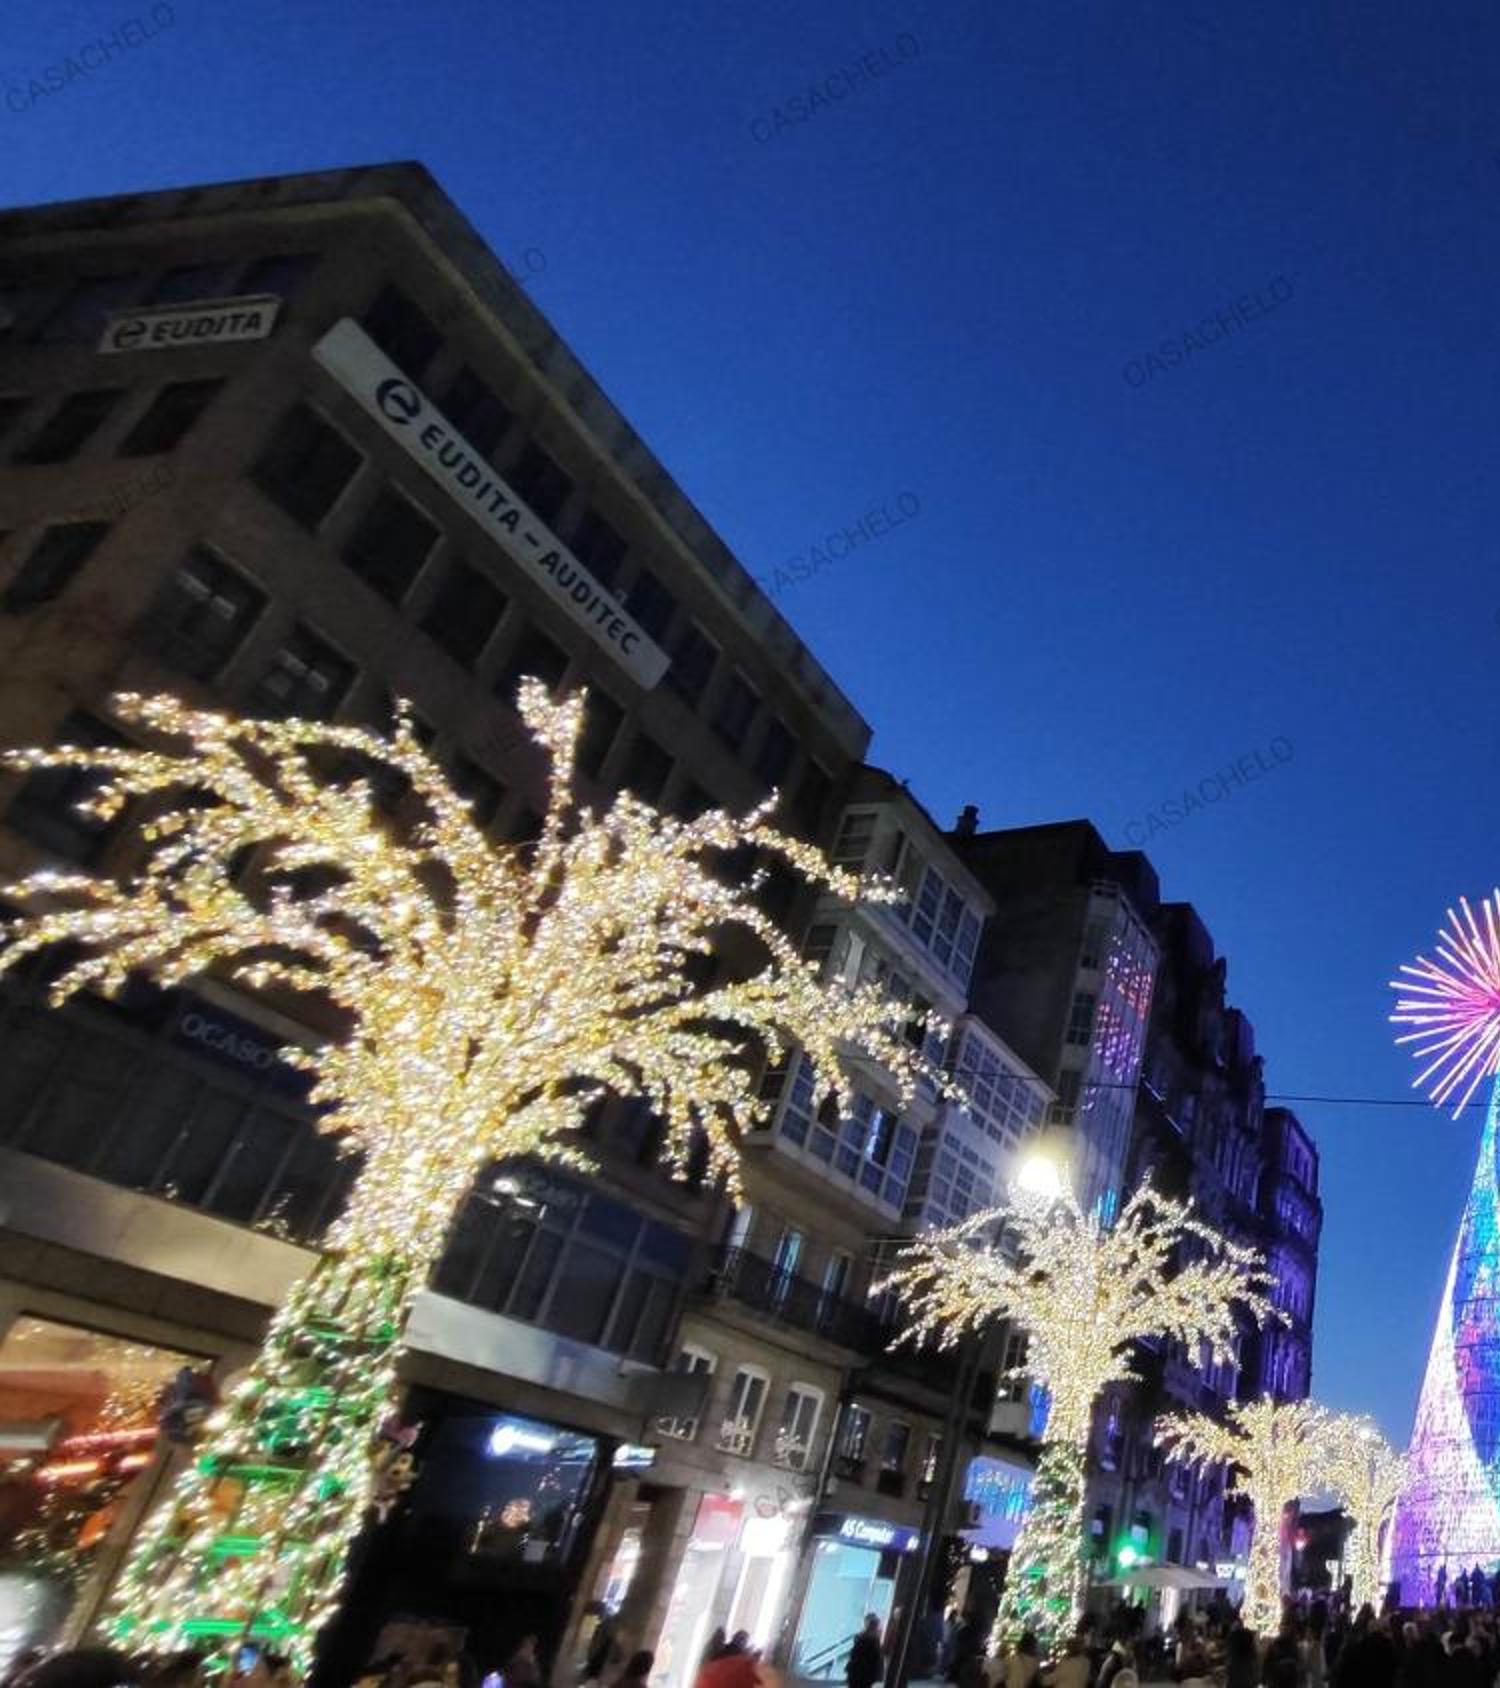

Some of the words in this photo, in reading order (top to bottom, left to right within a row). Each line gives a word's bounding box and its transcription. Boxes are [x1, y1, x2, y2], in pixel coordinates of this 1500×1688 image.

[152, 311, 263, 342] EUDITA
[420, 424, 520, 533] EUDITA
[538, 551, 640, 654] AUDITEC
